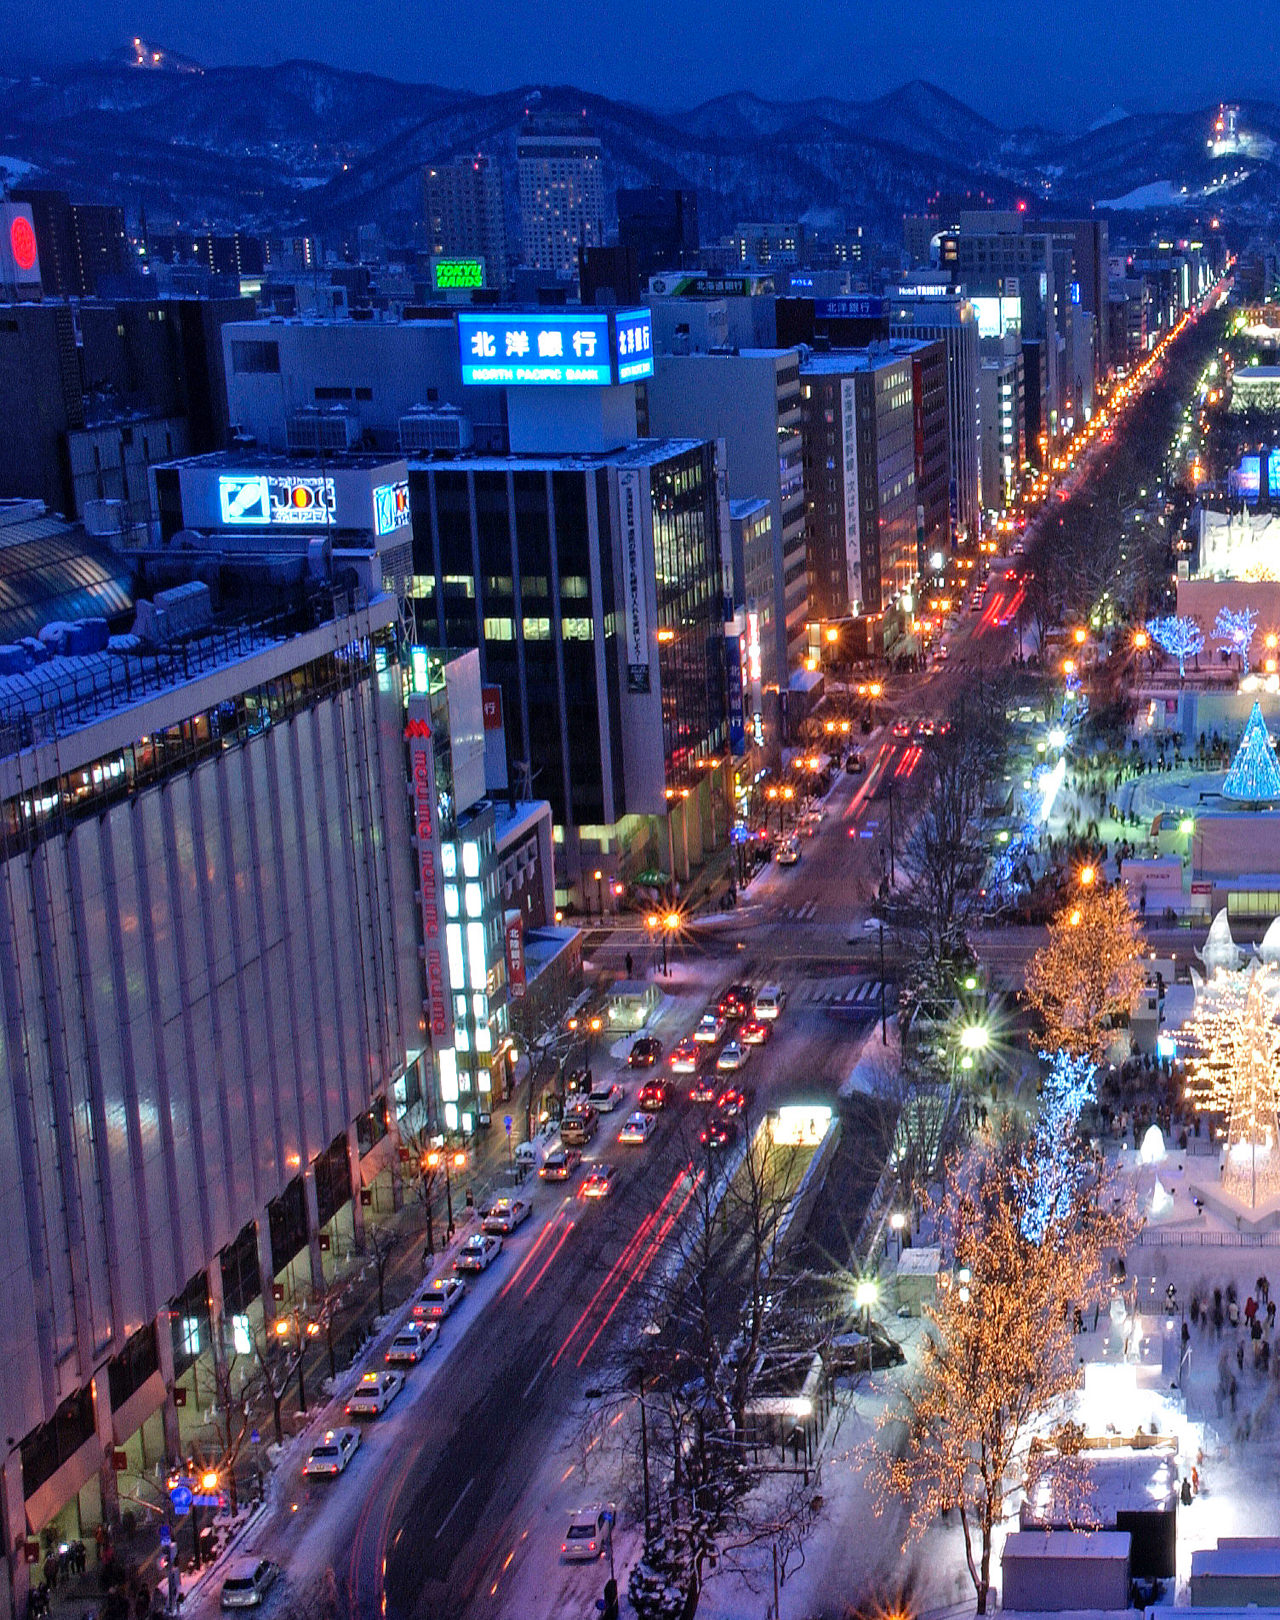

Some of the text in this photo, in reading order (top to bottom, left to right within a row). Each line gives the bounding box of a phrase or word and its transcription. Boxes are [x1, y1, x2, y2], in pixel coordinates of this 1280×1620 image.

[436, 264, 481, 276] TOKYU
[438, 276, 482, 287] HANDS
[792, 279, 813, 287] POLA
[899, 285, 947, 296] Hotel TRINITY
[471, 330, 597, 357] 北洋銀行
[619, 326, 650, 355] 北洋銀行
[472, 368, 599, 380] NORTH PACIFIC BANK
